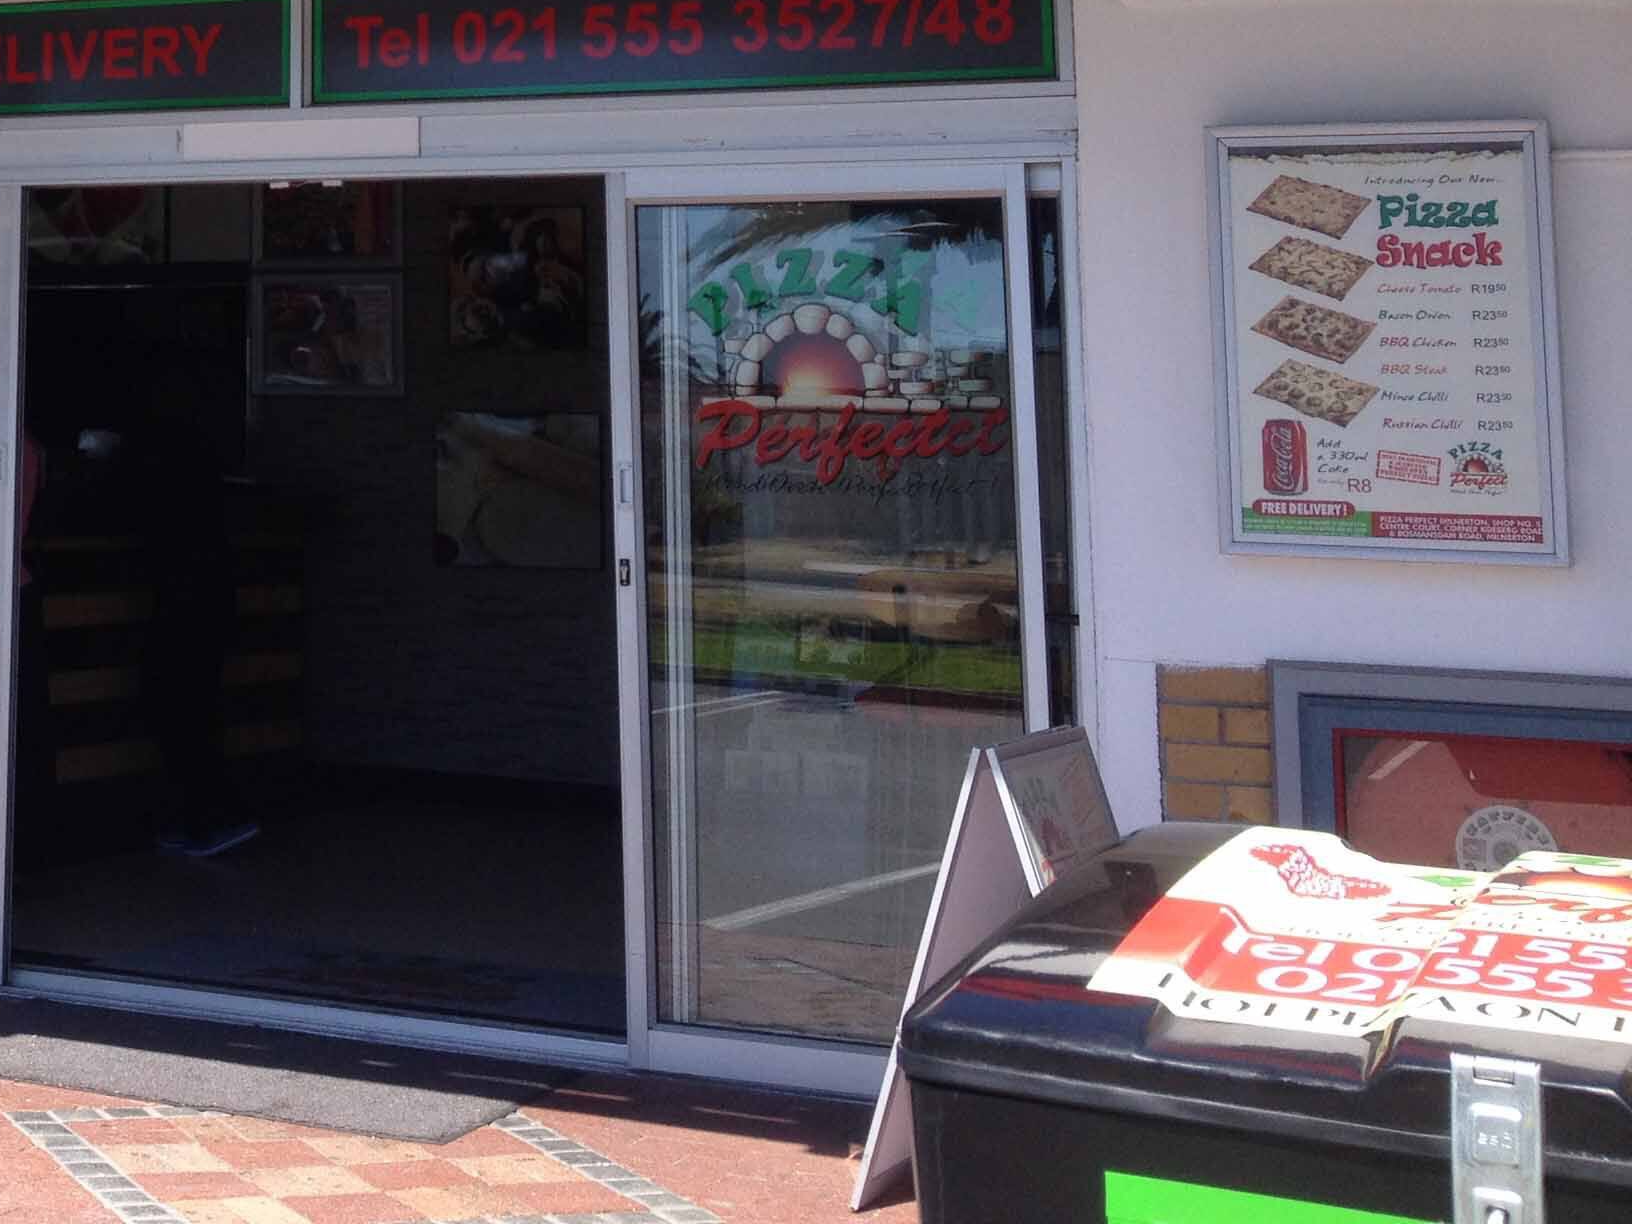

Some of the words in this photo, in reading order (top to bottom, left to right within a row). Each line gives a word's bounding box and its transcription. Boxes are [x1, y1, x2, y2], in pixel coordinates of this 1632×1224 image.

[346, 11, 429, 70] Tel
[452, 7, 559, 64] 021
[1376, 192, 1499, 229] Pizza
[1375, 231, 1504, 269] Snack
[686, 247, 923, 337] PIZZA
[1379, 336, 1409, 347] BBQ
[1380, 364, 1409, 375] BBQ
[1448, 440, 1504, 461] PIZZA
[1347, 478, 1373, 494] R8
[1261, 502, 1287, 515] FREE
[1219, 907, 1337, 965] Tel
[1515, 938, 1632, 972] 55
[1424, 957, 1596, 999] 555
